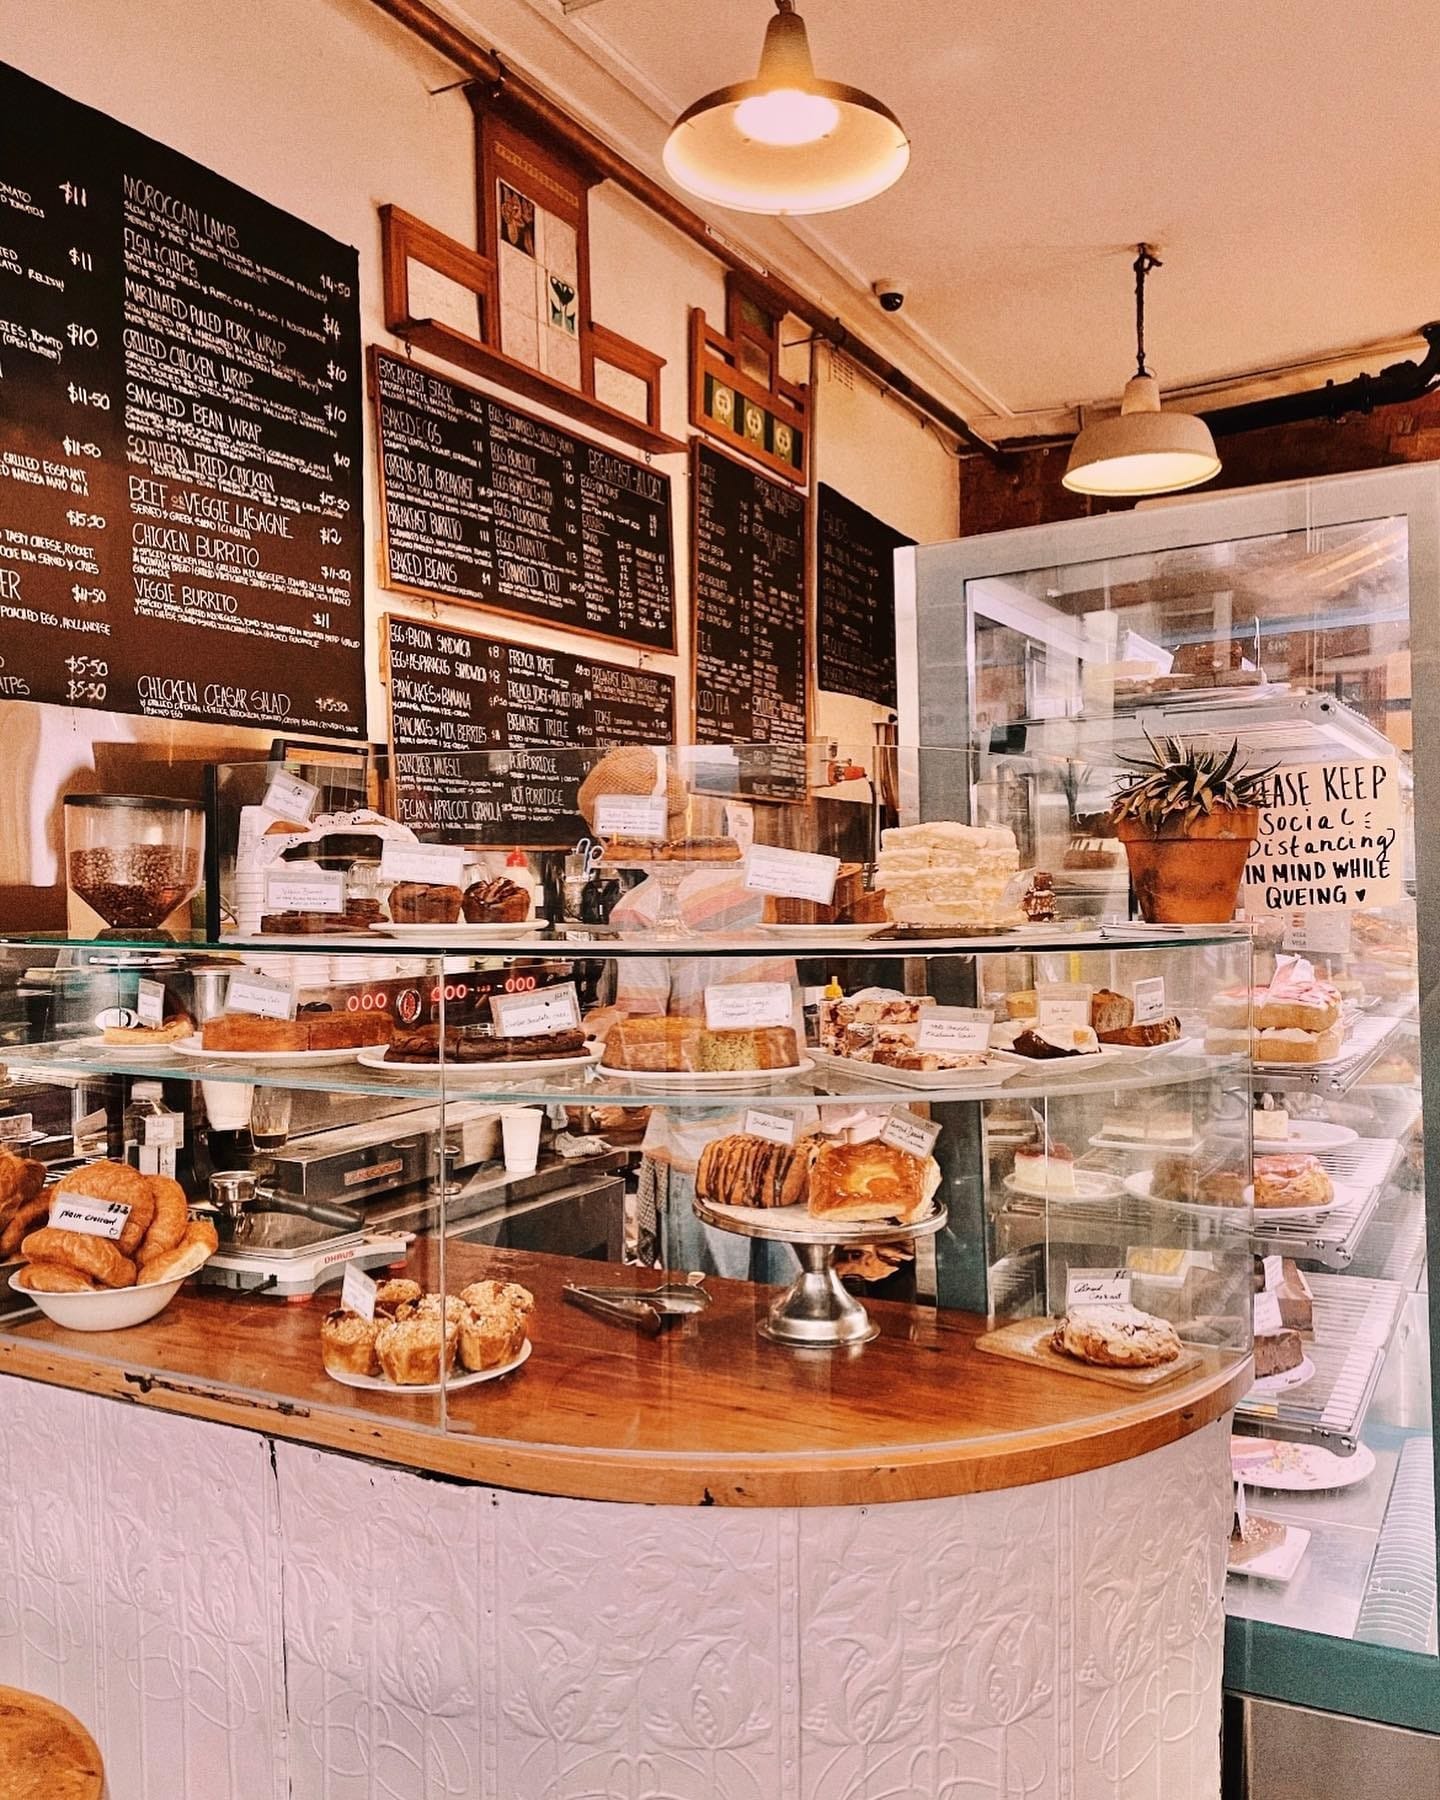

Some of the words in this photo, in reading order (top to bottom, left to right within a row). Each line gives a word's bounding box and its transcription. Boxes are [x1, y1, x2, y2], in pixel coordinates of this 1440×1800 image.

[59, 181, 87, 207] $11
[124, 173, 199, 232] MOROCCAN
[203, 213, 240, 249] LAMB
[69, 247, 92, 272] $11
[124, 228, 152, 258] FISH
[160, 246, 198, 279] CHIPS
[125, 276, 188, 320] MARINATED
[190, 304, 222, 334] PULLED
[225, 320, 254, 349] PORK
[255, 331, 287, 360] WRAP
[323, 313, 342, 340] $14
[67, 323, 98, 347] $10
[123, 328, 167, 360] GRILLED
[169, 346, 217, 380] CHICKEN
[221, 364, 254, 389] WRAP
[327, 360, 347, 382] $10
[378, 357, 426, 393] BREAKFAST
[428, 379, 455, 405] STACK
[126, 382, 186, 418] SMASHED
[192, 403, 224, 433] BEAN
[228, 414, 262, 444] WRAP
[323, 402, 347, 423] $10
[382, 404, 416, 436] BAKED
[416, 417, 442, 445] EGGS
[3, 452, 39, 471] GRILLED
[127, 435, 189, 470] SOUTHERN
[193, 452, 228, 480] FRIED
[229, 465, 276, 493] CHICKEN
[333, 451, 351, 468] $10
[490, 441, 507, 465] EGGS
[507, 448, 536, 475] BENEDICT
[417, 462, 434, 489] BIG
[435, 468, 474, 500] BREAKFAST
[492, 471, 509, 492] EGGS
[129, 475, 168, 508] BEEF
[182, 490, 231, 524] VEGGIE
[235, 503, 294, 540] LASAGNE
[319, 527, 342, 545] $12
[387, 501, 427, 533] BREAKFAST
[429, 512, 463, 541] BURRITO
[493, 499, 512, 519] EGGS
[132, 522, 190, 554] CHICKEN
[196, 534, 260, 568] BURRITO
[321, 566, 352, 581] $11-50
[495, 529, 516, 552] EGGS
[390, 548, 422, 577] BAKED
[424, 556, 458, 583] BEANS
[71, 584, 107, 603] $11-50
[134, 577, 176, 603] VEGGIE
[182, 586, 239, 614] BURRITO
[312, 612, 329, 629] $11
[65, 656, 108, 677] $5-50
[508, 648, 535, 669] FRENCH
[536, 655, 556, 675] TOAST
[66, 679, 107, 700] $5-50
[137, 675, 198, 704] CHICKEN
[203, 683, 250, 714] CEASAR
[250, 690, 292, 717] SALAD
[507, 680, 532, 700] FRENCH
[393, 714, 434, 737] PANCAKES
[457, 724, 487, 744] BERRIES
[507, 712, 541, 734] BREAKFAST
[509, 751, 524, 770] HOT
[524, 754, 557, 775] PORRIDGE
[511, 785, 524, 805] HOT
[525, 786, 565, 807] PORRIDGE
[1254, 771, 1312, 808] EASE
[1322, 765, 1387, 802] KEEP
[398, 798, 429, 820] PECAN
[434, 799, 470, 821] APRICOT
[471, 801, 503, 822] GRANOLA
[1259, 808, 1354, 835] Social
[1248, 828, 1395, 862] Distancing
[1245, 864, 1266, 884] IN
[1272, 861, 1326, 884] MIND
[1331, 857, 1390, 880] WHILE
[1265, 885, 1347, 909] QUEING
